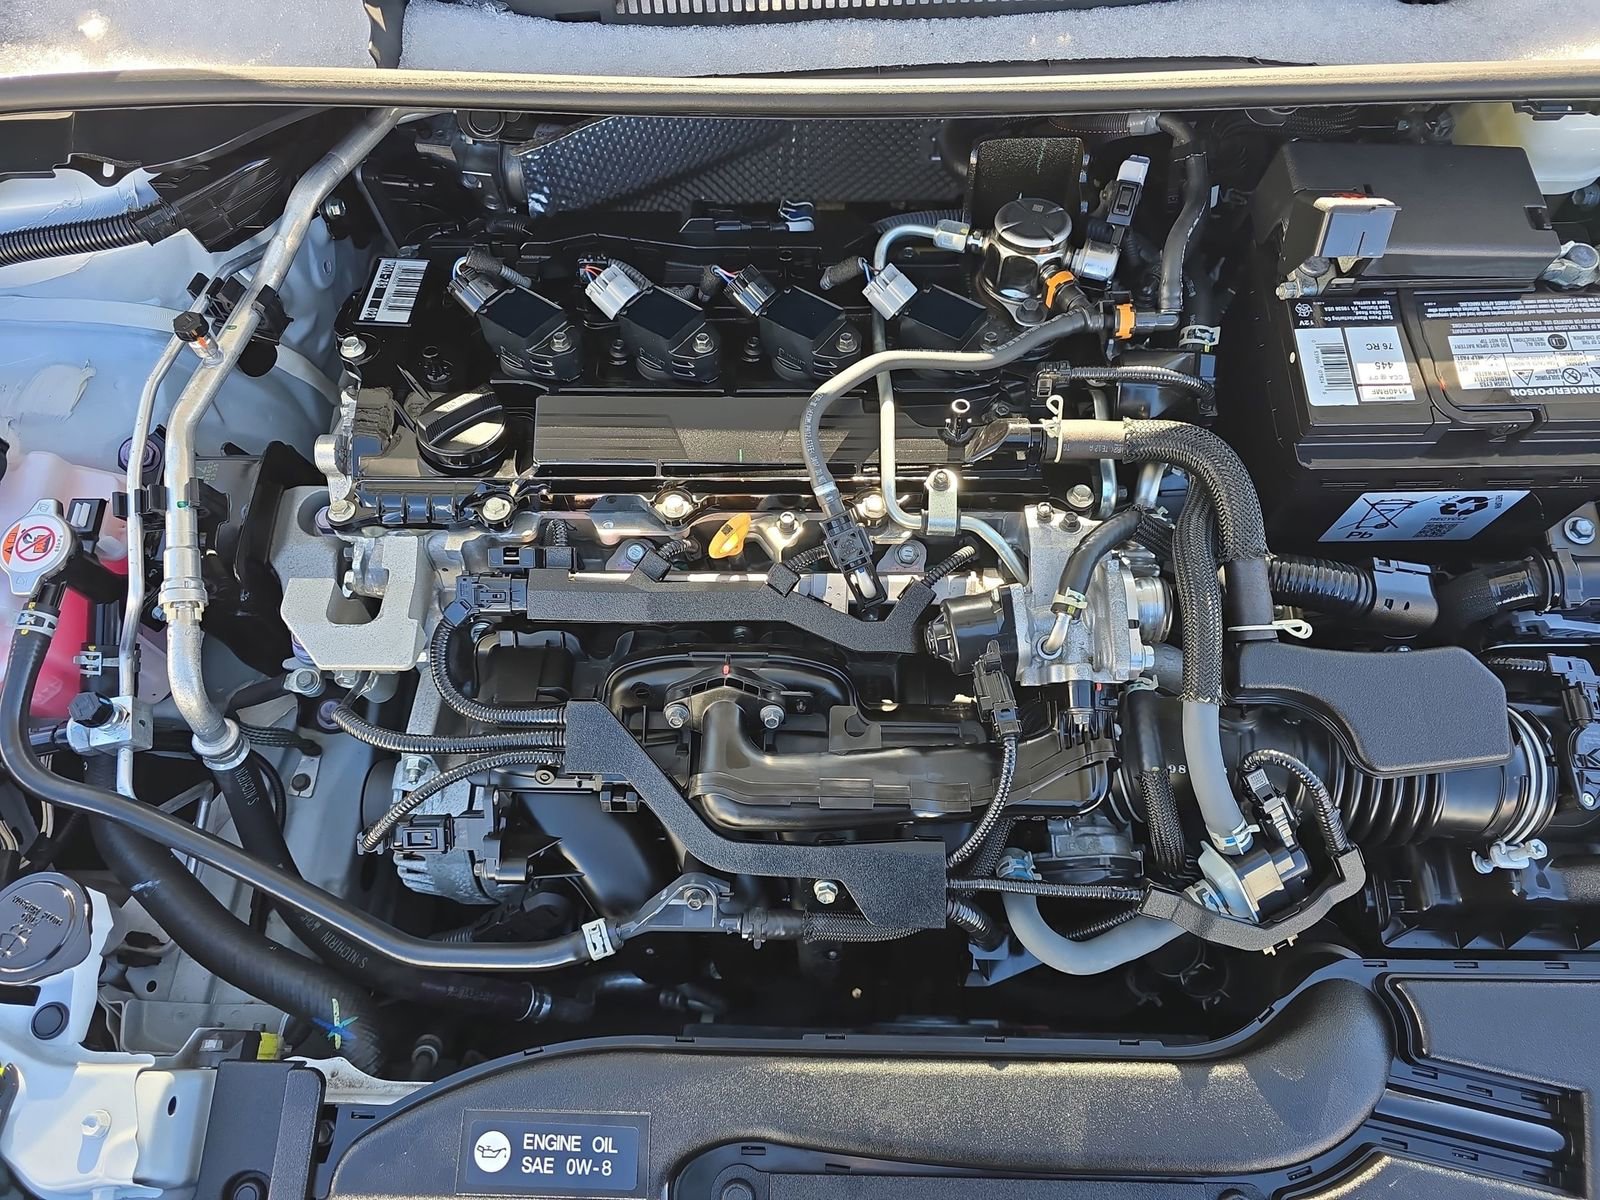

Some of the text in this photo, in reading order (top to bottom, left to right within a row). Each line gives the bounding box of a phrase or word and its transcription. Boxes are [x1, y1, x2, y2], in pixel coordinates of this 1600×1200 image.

[1366, 343, 1394, 351] 76 RC
[1374, 361, 1394, 370] 445
[1345, 531, 1374, 539] Pb
[320, 931, 360, 964] NICHIRIN
[523, 1133, 618, 1154] ENGINE OIL
[521, 1156, 612, 1176] SAE 0W-8
